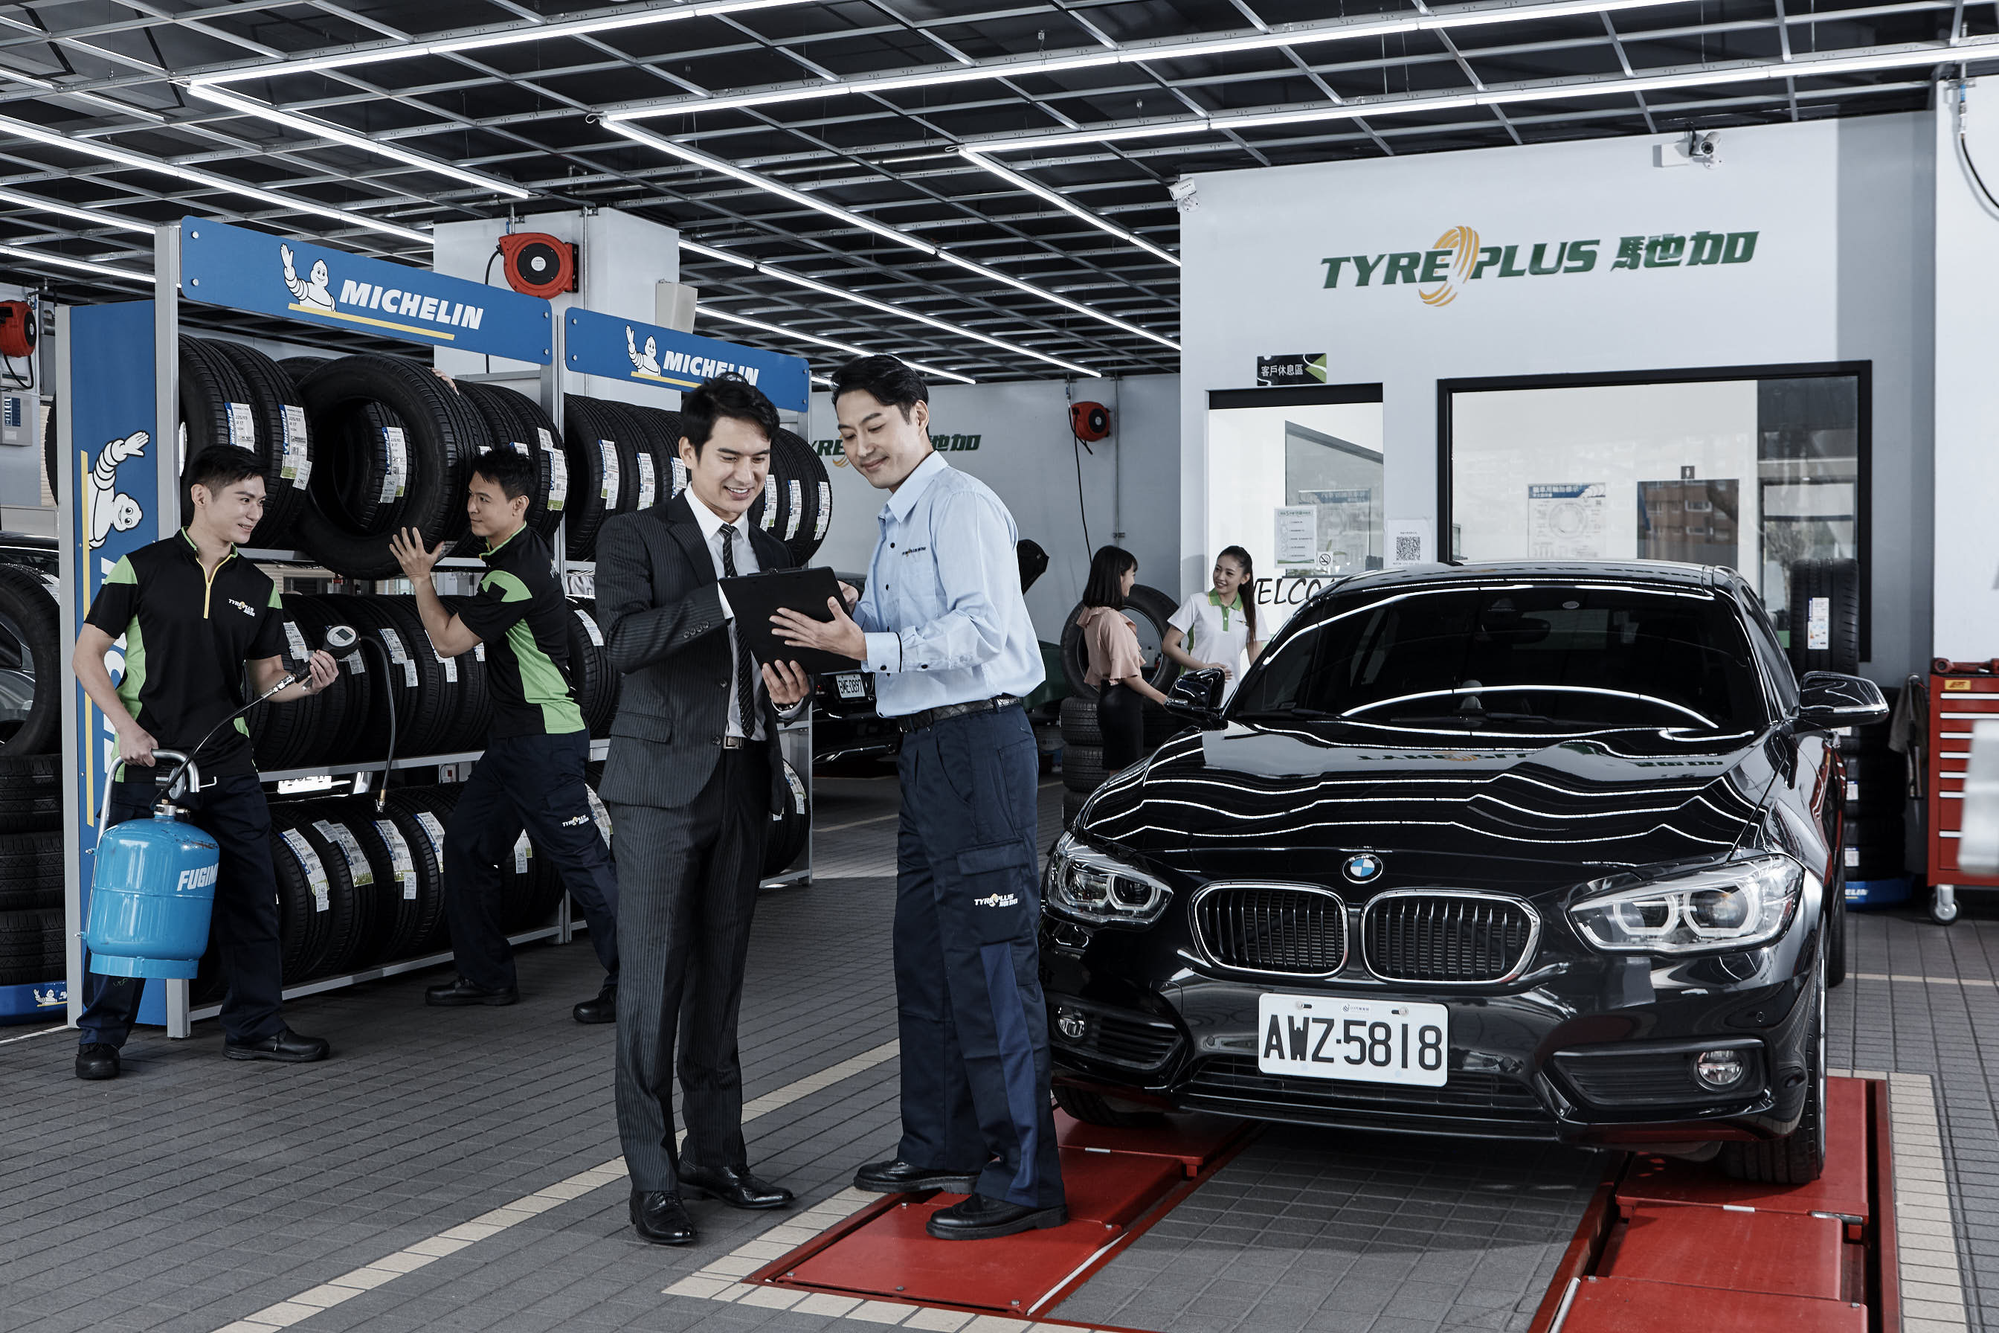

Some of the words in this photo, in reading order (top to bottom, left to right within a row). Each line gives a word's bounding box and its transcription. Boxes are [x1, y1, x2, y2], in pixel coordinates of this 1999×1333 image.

[1610, 230, 1760, 273] 馳加
[339, 279, 484, 330] MICHELIN
[1263, 1014, 1442, 1071] AWZ-5818
